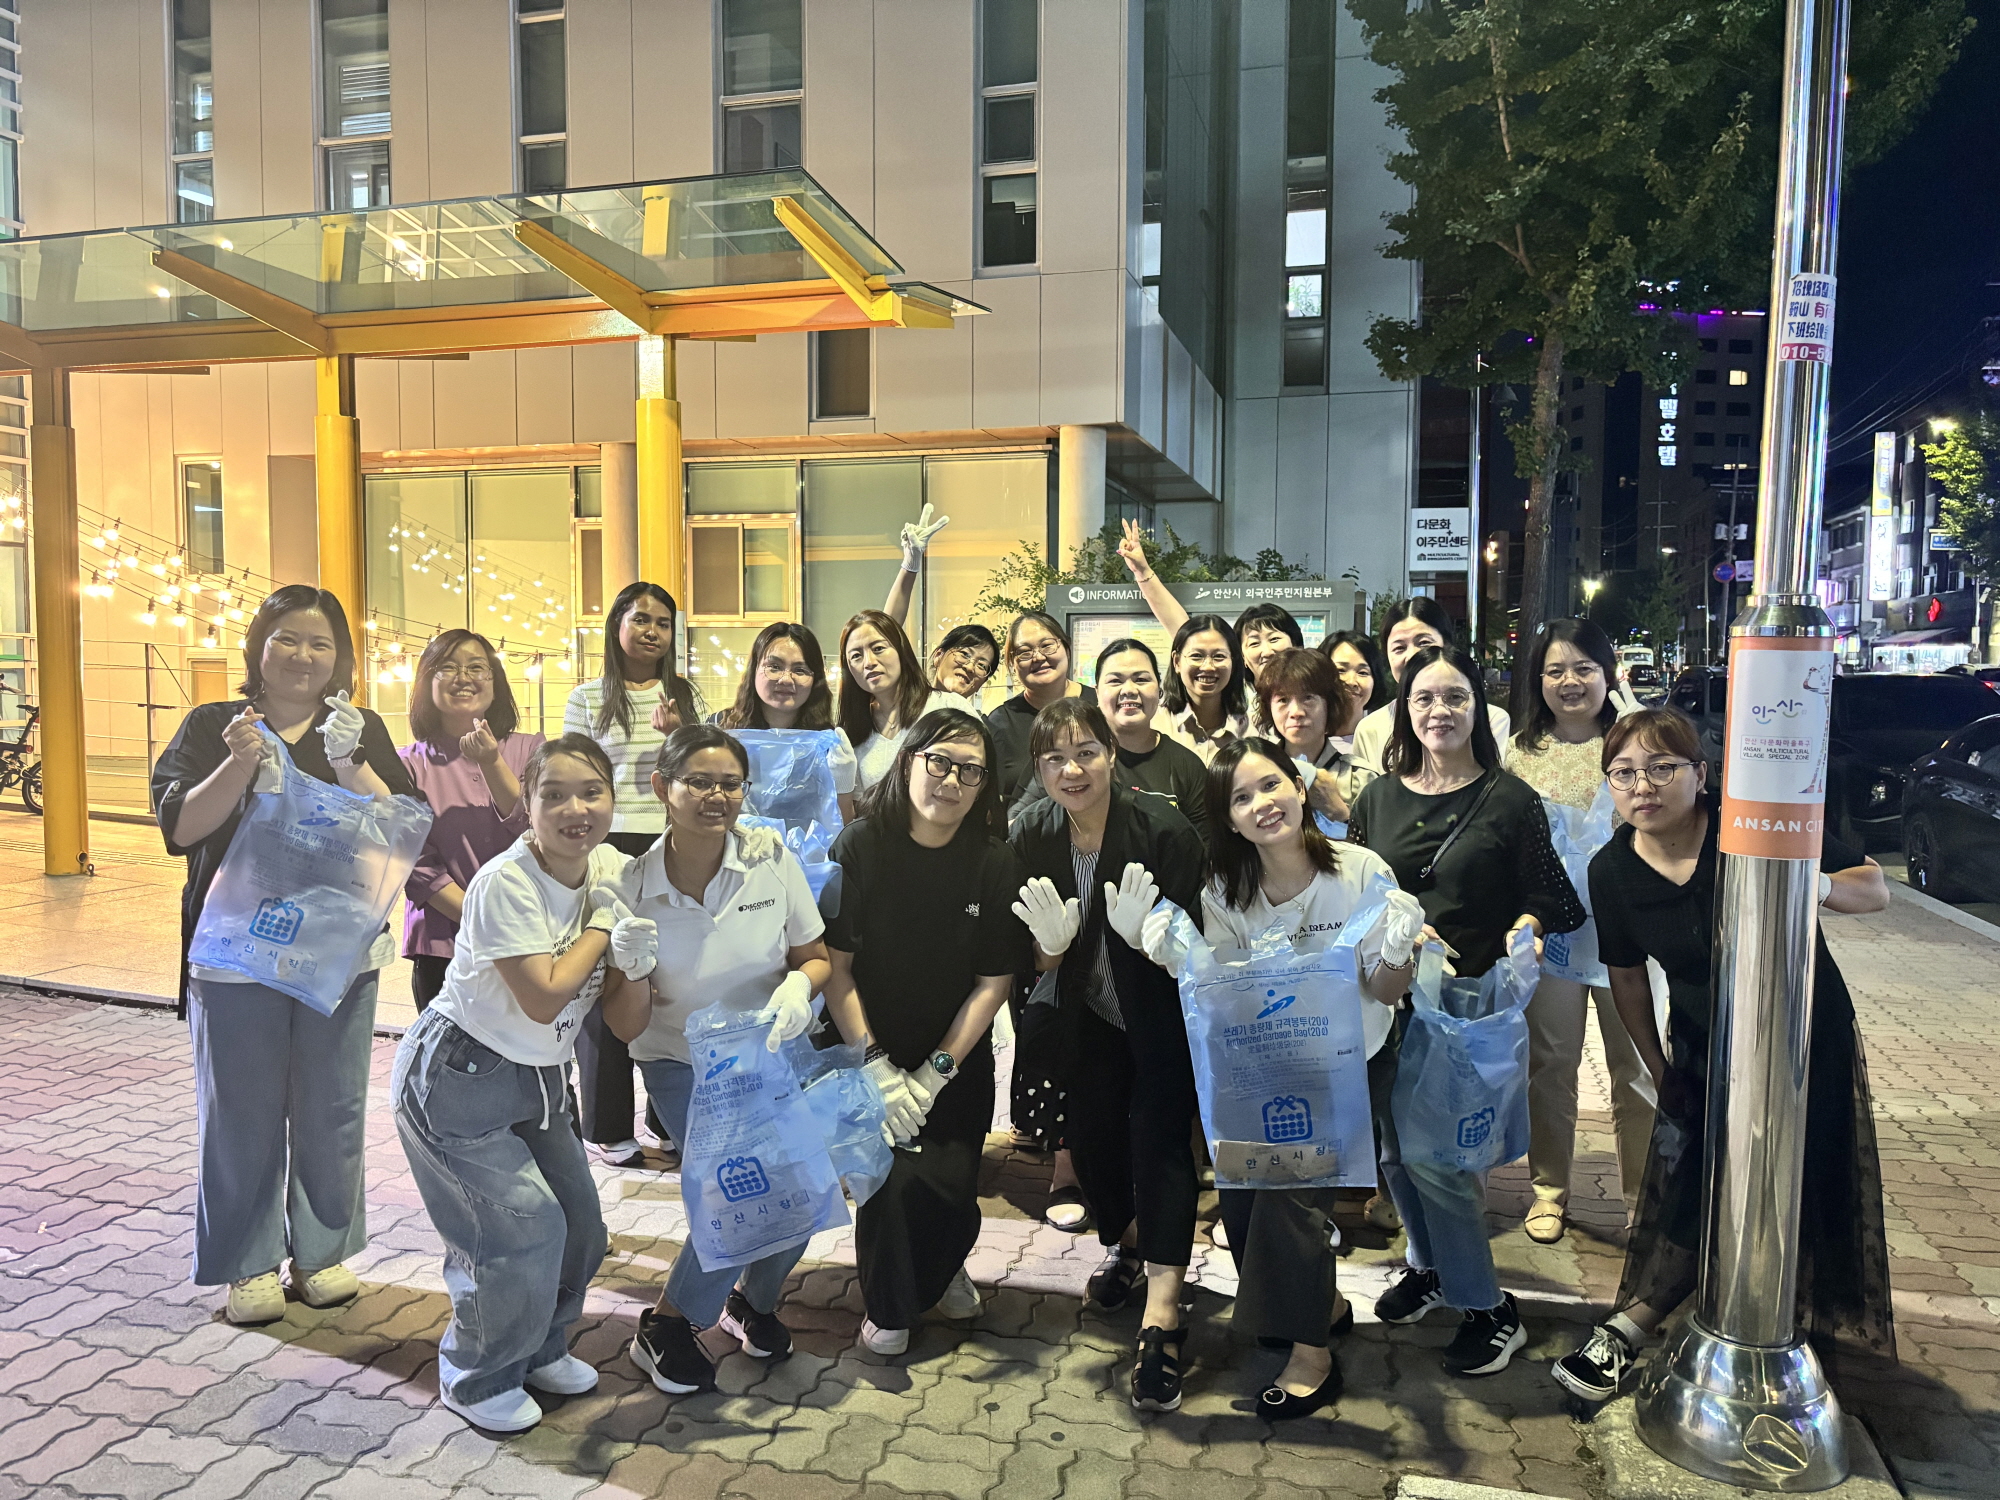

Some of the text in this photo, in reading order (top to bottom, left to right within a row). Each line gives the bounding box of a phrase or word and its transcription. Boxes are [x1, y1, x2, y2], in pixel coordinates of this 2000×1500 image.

[1417, 518, 1451, 530] 다문화
[1086, 590, 1146, 600] INFORMATI
[1213, 587, 1333, 599] 안산시 외국인주민지원본부
[1733, 815, 1801, 833] ANSAN
[555, 1018, 575, 1042] you
[1224, 1024, 1247, 1037] 쓰레기
[1249, 1021, 1273, 1035] 종량제
[1263, 1029, 1292, 1042] Garbage
